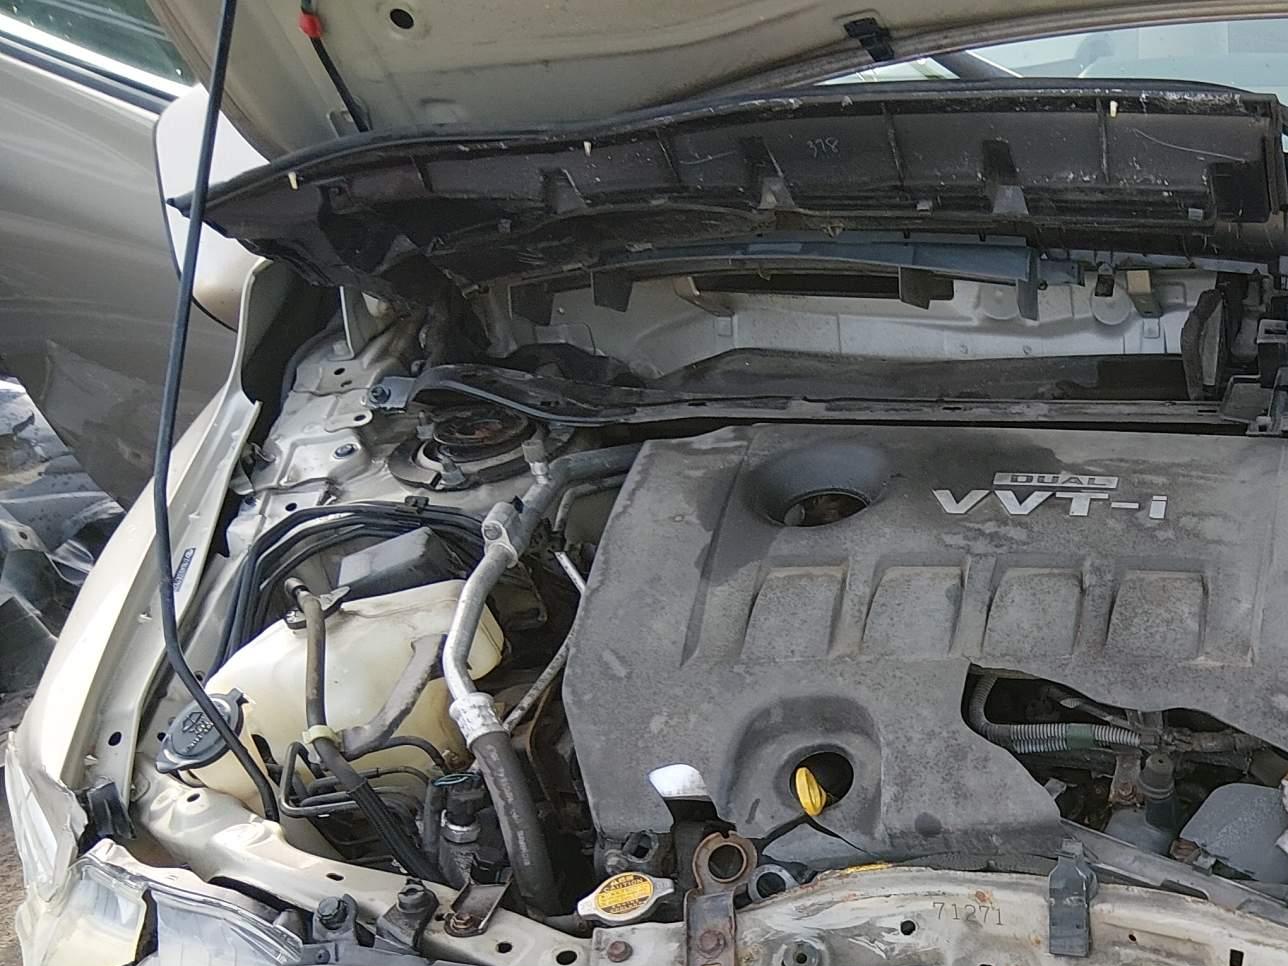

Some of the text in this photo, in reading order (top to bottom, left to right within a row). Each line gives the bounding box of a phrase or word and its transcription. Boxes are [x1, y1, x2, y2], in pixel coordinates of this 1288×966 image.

[1010, 475, 1106, 486] DUAL
[931, 488, 1167, 519] VVT-i
[932, 901, 1005, 926] 71271
